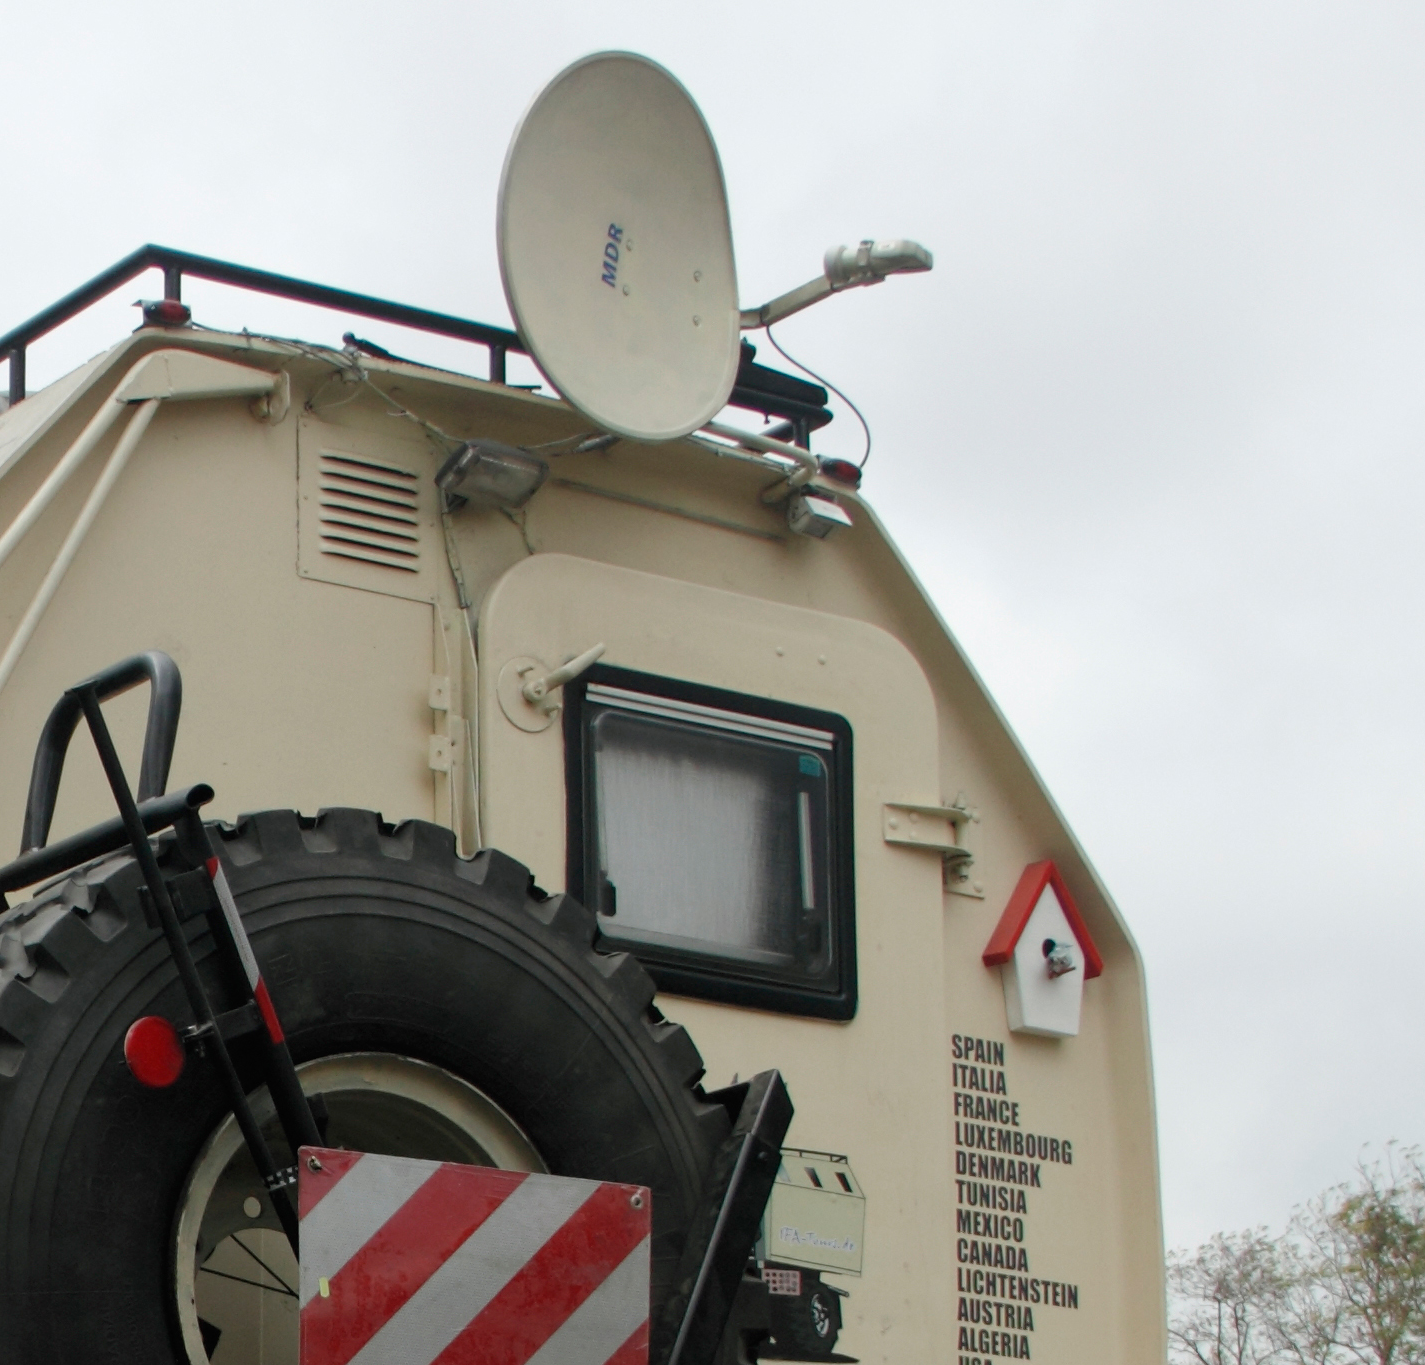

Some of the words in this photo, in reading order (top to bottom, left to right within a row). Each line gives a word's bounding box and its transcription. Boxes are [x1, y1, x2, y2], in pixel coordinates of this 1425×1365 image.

[601, 222, 623, 288] MDR
[952, 1034, 1004, 1066] SPAIN
[952, 1063, 1007, 1095] ITALIA
[954, 1092, 1019, 1126] FRANCE
[955, 1121, 1072, 1165] LUXEMBOURG
[955, 1150, 1041, 1188] DENMARK
[955, 1179, 1027, 1214] TUNISIA
[956, 1208, 1024, 1242] MEXICO
[957, 1238, 1029, 1272] CANADA
[957, 1267, 1078, 1309] LICHTENSTEIN
[957, 1297, 1034, 1331] AUSTRIA
[958, 1326, 1030, 1360] ALGERIA
